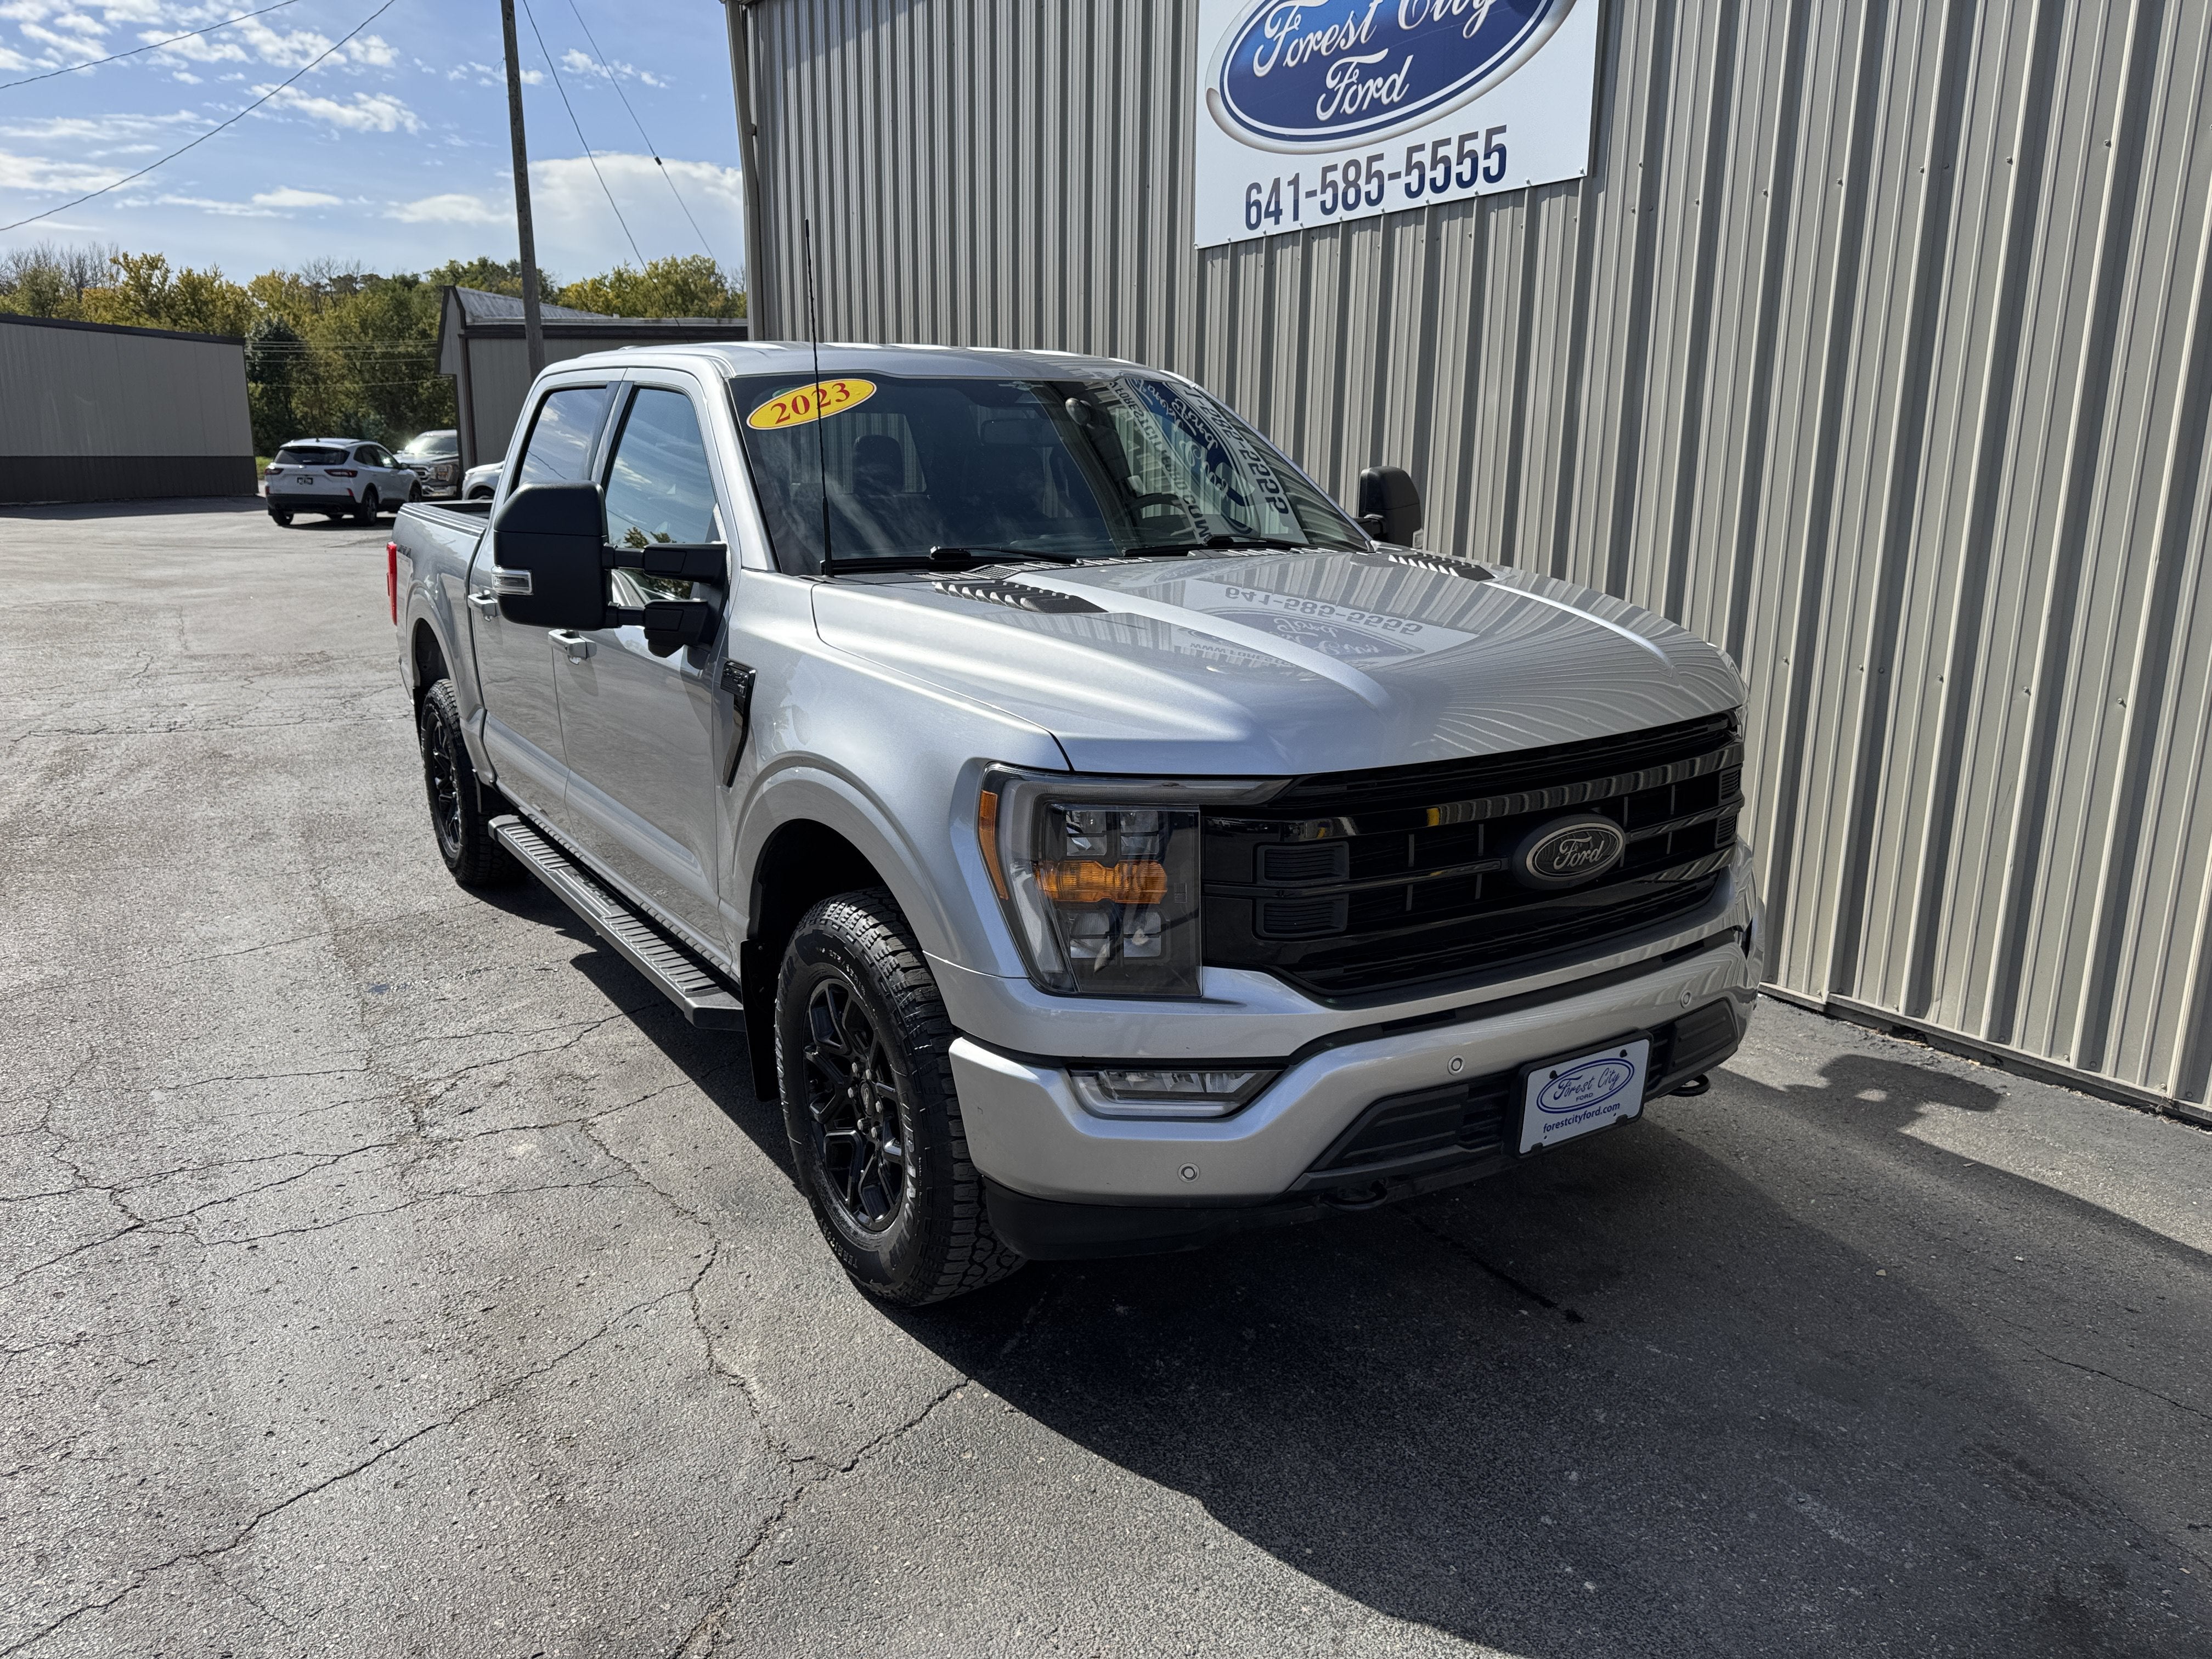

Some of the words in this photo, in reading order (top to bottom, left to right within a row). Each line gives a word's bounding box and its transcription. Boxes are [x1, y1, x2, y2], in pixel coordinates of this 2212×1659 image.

[1253, 0, 1384, 77] Forest
[1316, 48, 1414, 121] Ford
[1245, 124, 1508, 231] 641-585-5555
[770, 382, 850, 425] 2023
[1553, 836, 1605, 870] Ford
[1553, 1075, 1595, 1101] Forest
[1598, 1067, 1620, 1091] City
[1576, 1092, 1594, 1102] FORD
[1543, 1102, 1621, 1133] forestcityford.com
